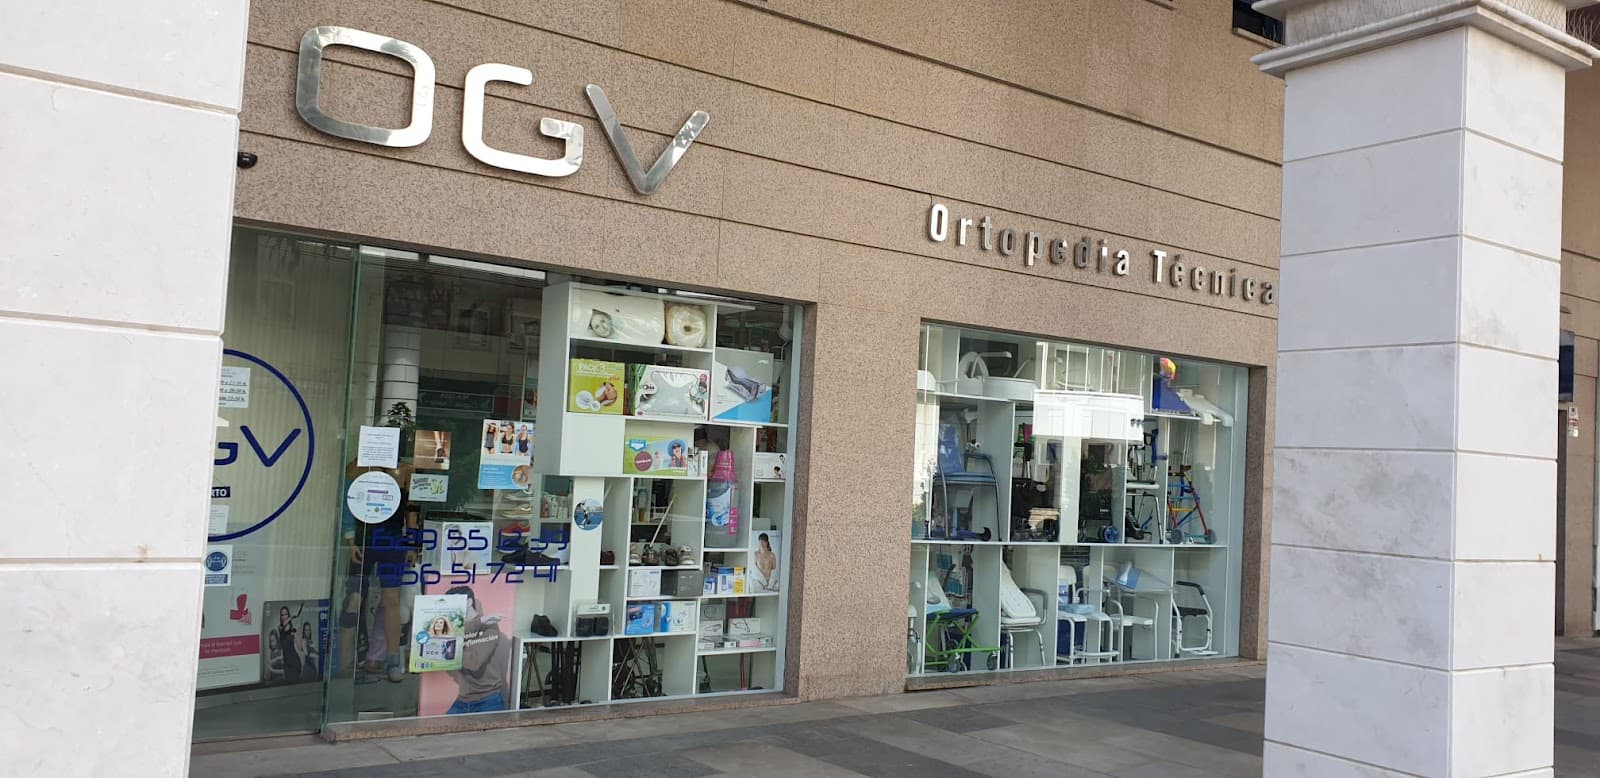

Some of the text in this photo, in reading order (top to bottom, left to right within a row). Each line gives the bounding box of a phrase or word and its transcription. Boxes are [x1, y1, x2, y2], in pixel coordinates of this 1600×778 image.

[295, 25, 711, 195] OGV
[926, 203, 1275, 306] Ortopedia Técnica
[371, 528, 570, 551] 629 55 12 39
[377, 562, 558, 585] 956 51 72 41
